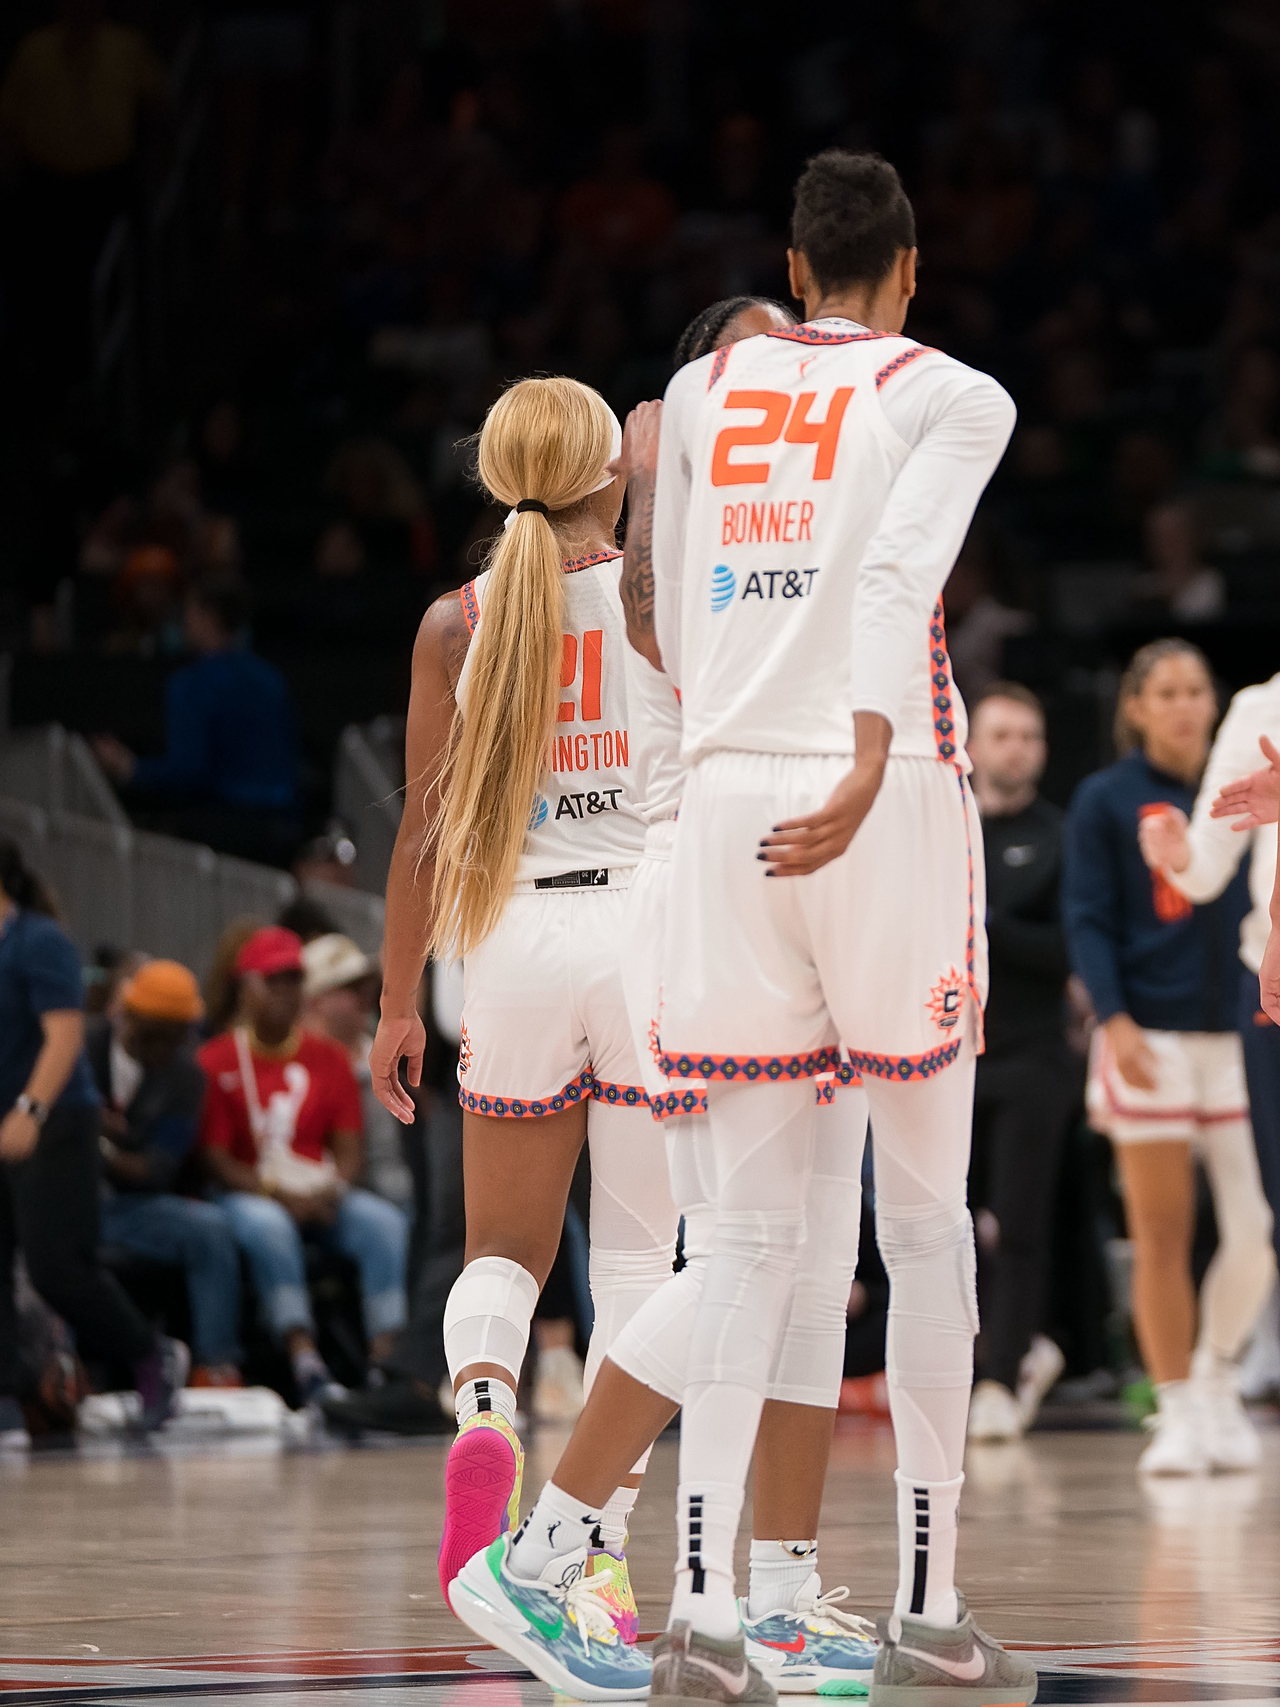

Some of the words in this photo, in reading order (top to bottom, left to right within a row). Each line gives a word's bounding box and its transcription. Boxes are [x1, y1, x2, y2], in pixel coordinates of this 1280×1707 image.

[710, 386, 855, 487] 24
[722, 500, 814, 546] BONNER
[741, 567, 820, 600] AT&T
[550, 729, 629, 773] INGTON
[554, 788, 623, 820] AT&T
